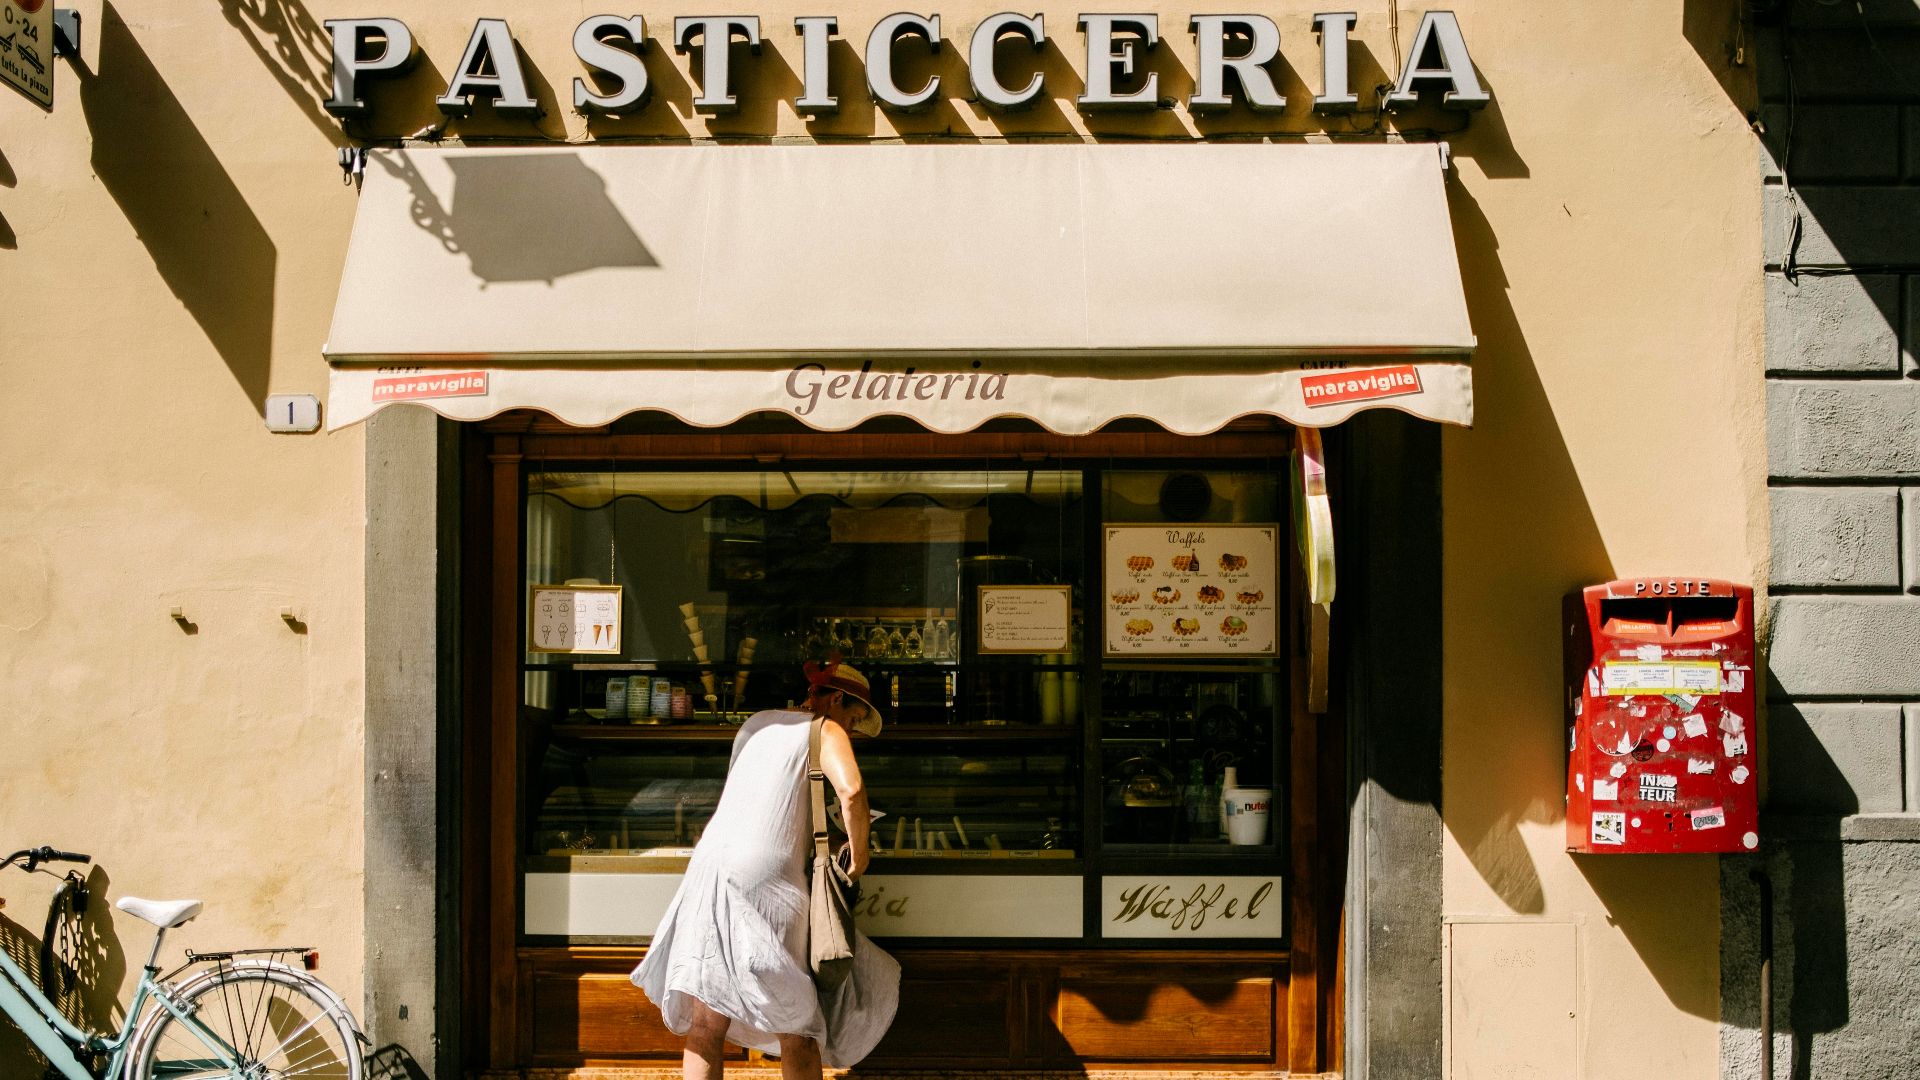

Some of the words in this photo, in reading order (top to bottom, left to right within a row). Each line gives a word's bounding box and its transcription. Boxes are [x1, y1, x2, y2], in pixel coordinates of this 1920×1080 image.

[323, 10, 1490, 112] PASTICCERIA
[21, 68, 28, 83] la
[29, 77, 49, 97] piazza
[374, 376, 485, 397] maraviglia
[785, 359, 1009, 416] Gelateria
[1304, 373, 1416, 399] maraviglia
[287, 401, 295, 425] 1
[1165, 530, 1206, 549] Waffels
[1634, 581, 1711, 597] POSTE
[1112, 881, 1274, 932] Waffel
